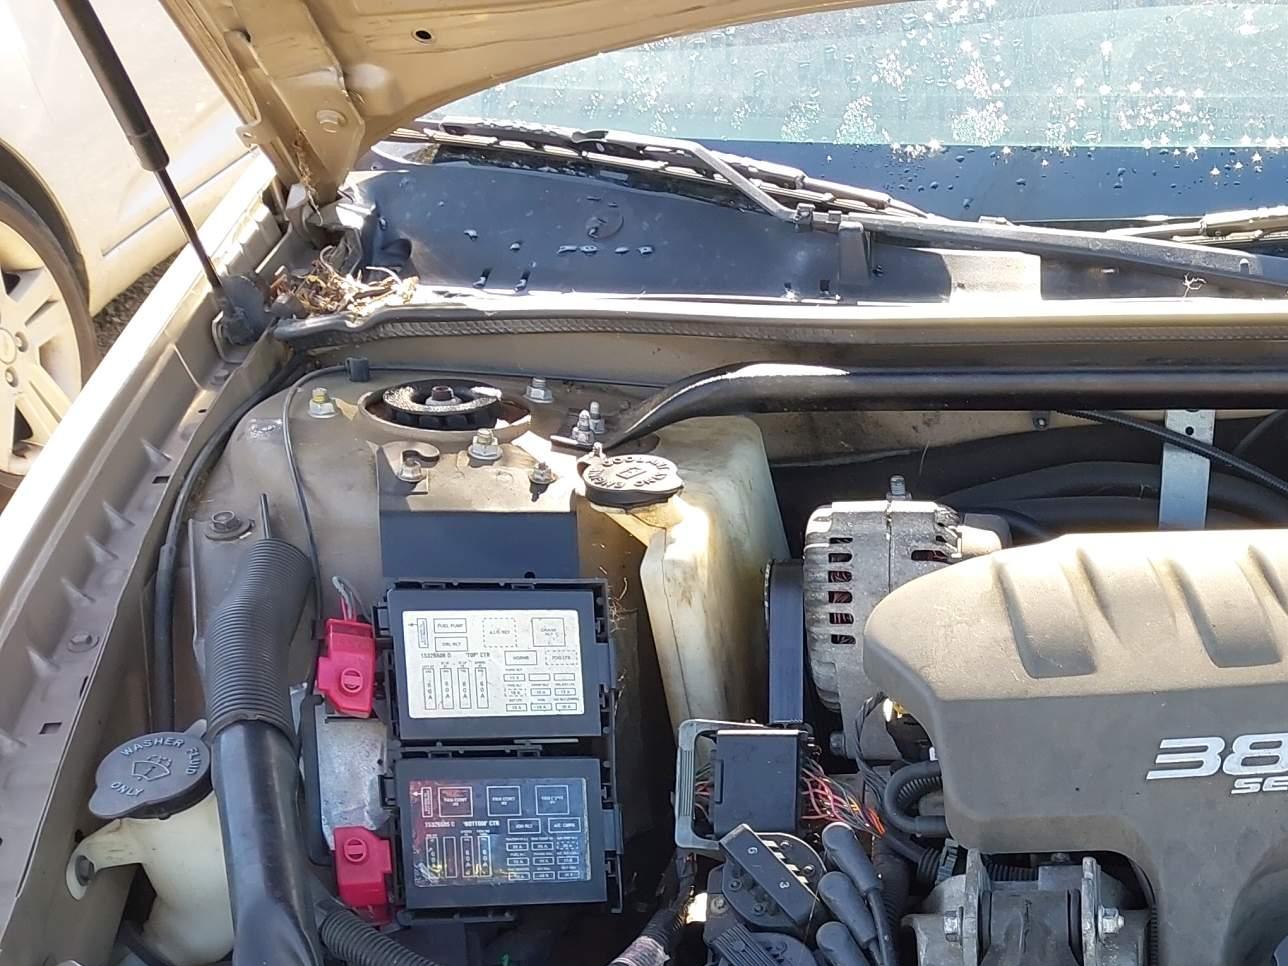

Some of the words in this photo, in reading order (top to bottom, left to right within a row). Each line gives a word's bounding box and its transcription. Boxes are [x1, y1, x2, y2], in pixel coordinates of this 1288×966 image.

[120, 738, 185, 756] WASHER
[185, 747, 201, 775] FLUID
[111, 781, 144, 797] ONLY
